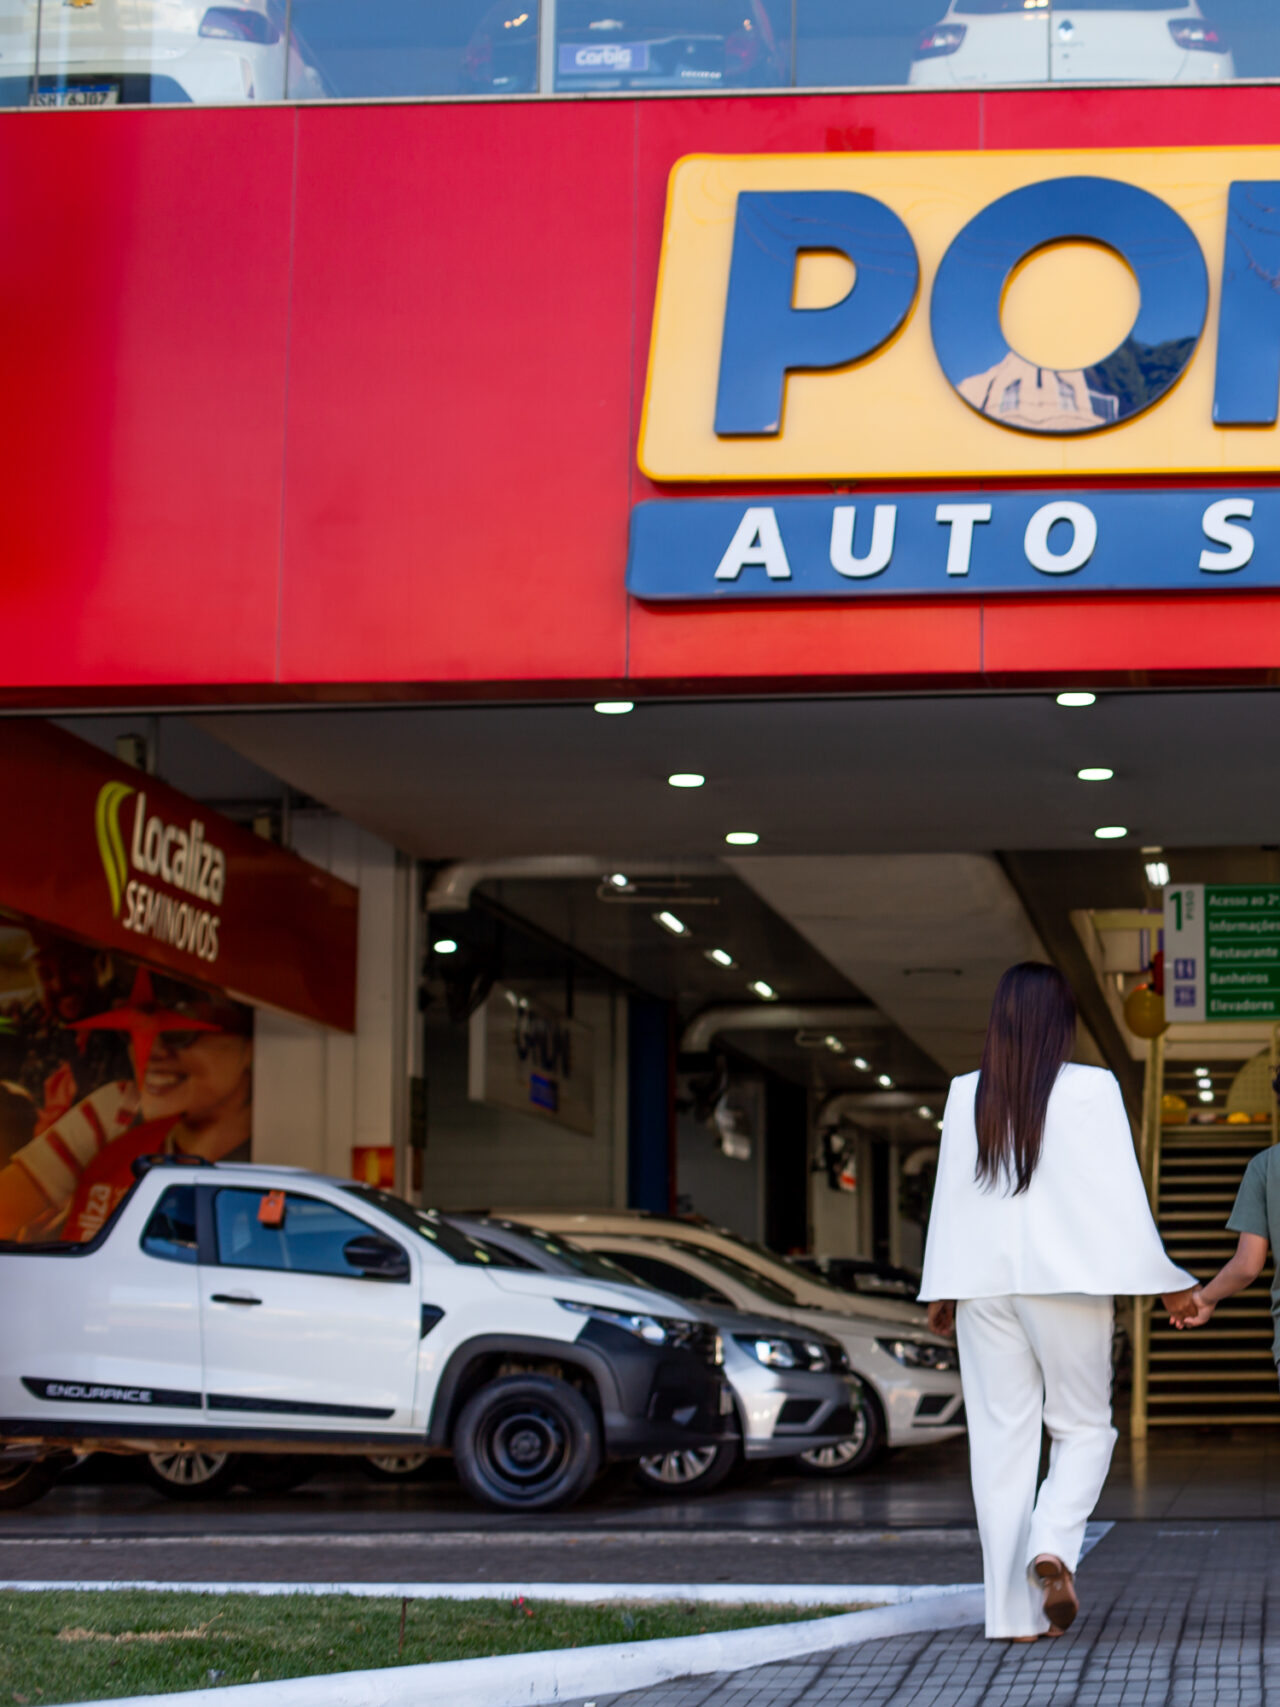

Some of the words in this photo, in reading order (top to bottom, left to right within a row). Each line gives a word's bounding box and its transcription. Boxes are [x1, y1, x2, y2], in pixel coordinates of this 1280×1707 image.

[714, 500, 1098, 580] AUTO
[132, 792, 226, 906] Localiza
[1208, 894, 1248, 906] Acesso
[1251, 895, 1265, 906] ao
[1169, 891, 1182, 931] 1
[122, 879, 220, 963] SEMINOVOS
[1209, 919, 1280, 933] Informações
[1209, 946, 1278, 958] Restaurante
[1210, 972, 1269, 985] Banheiros
[1210, 999, 1275, 1011] Elevadores
[46, 1384, 151, 1403] ENDURANCE
